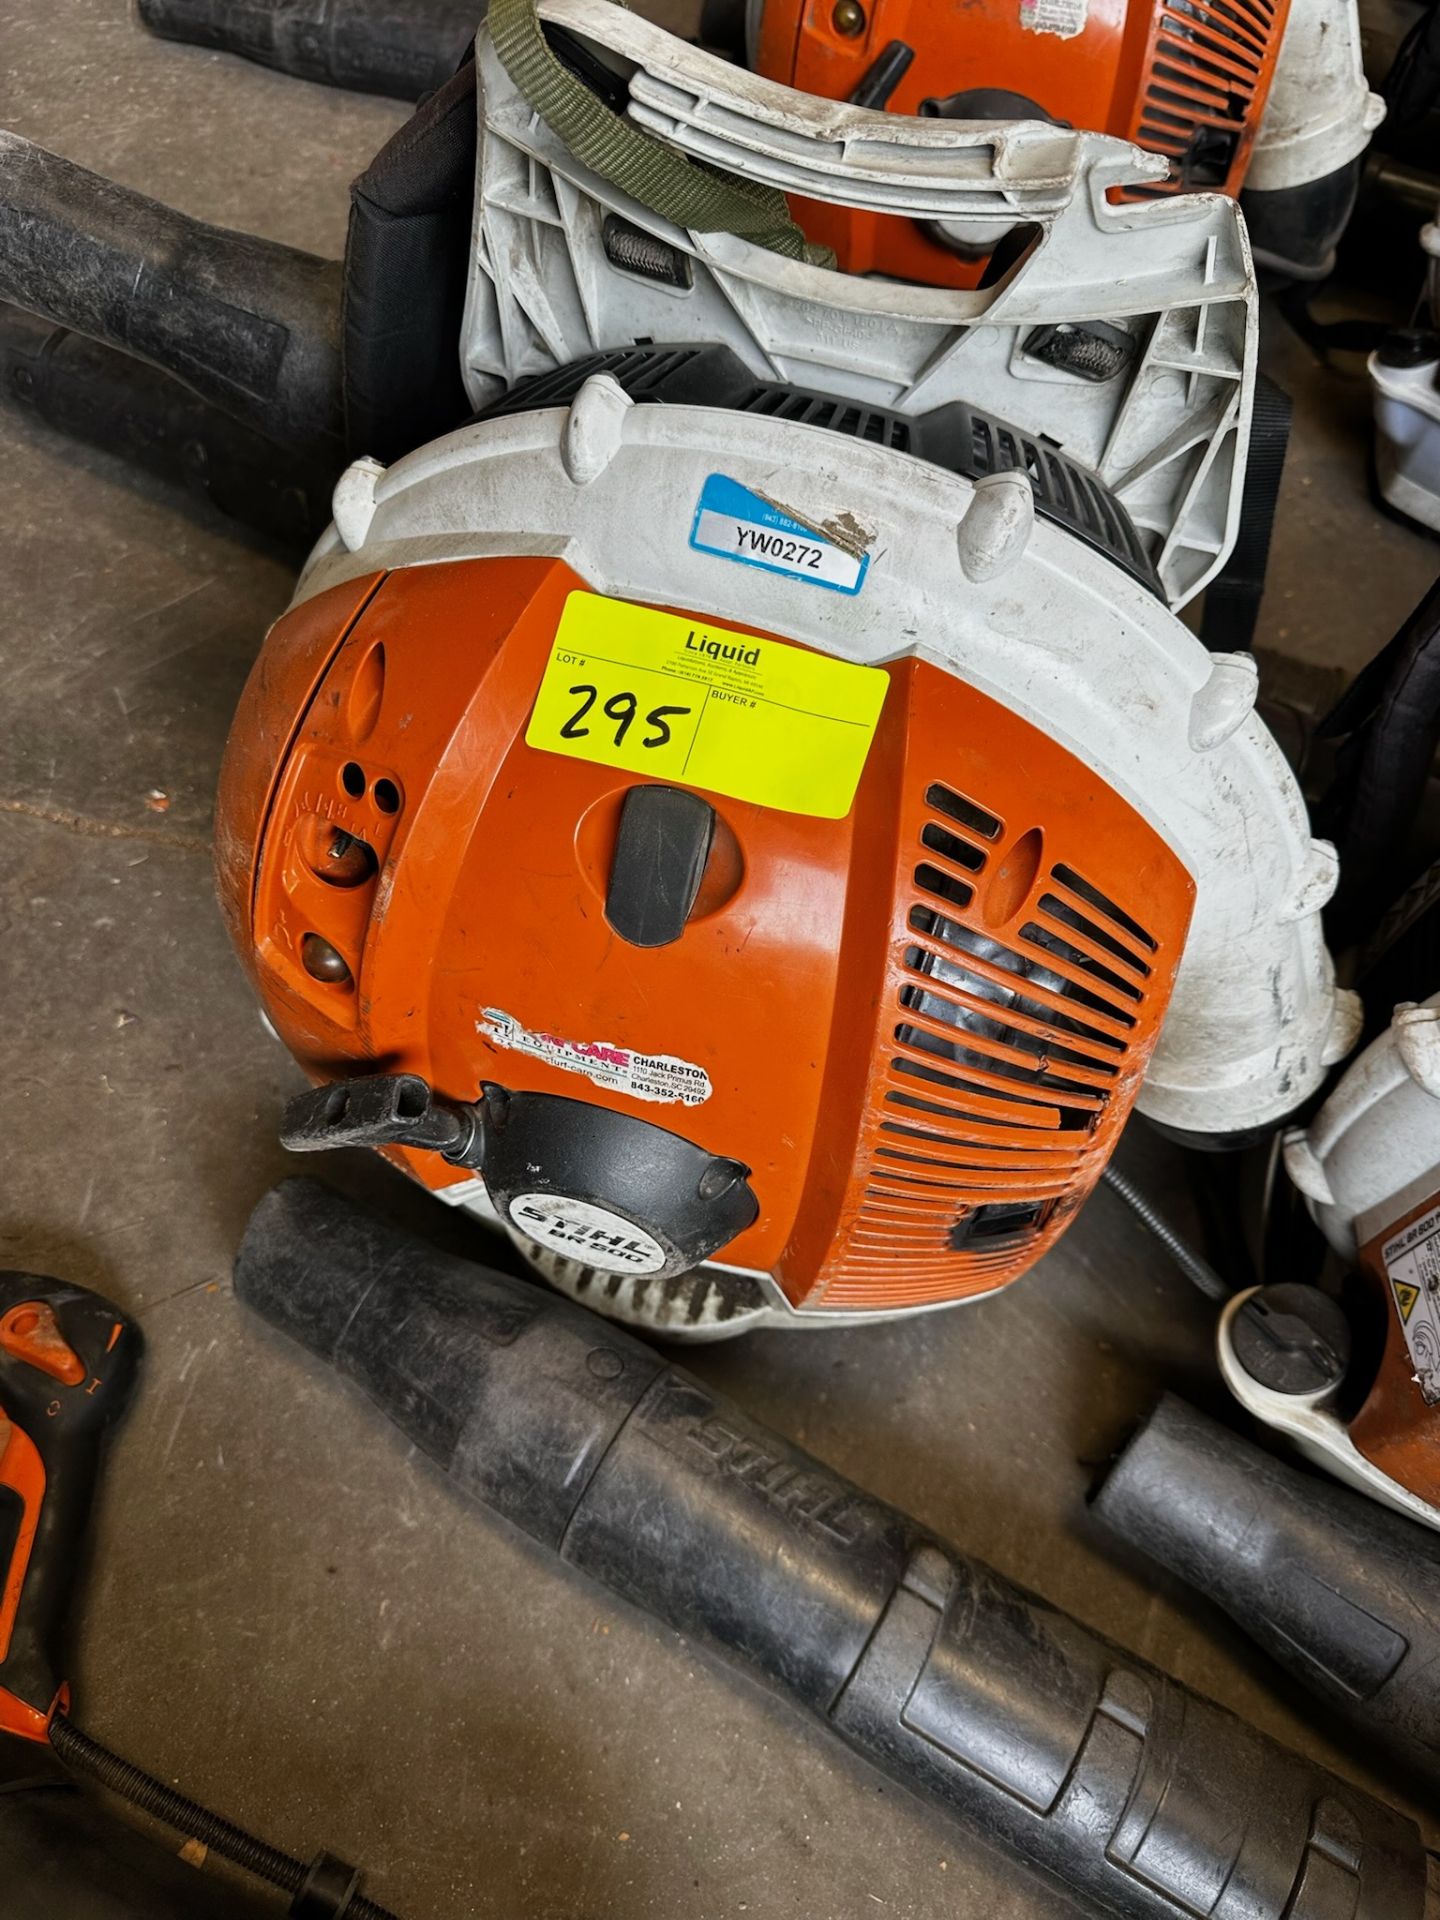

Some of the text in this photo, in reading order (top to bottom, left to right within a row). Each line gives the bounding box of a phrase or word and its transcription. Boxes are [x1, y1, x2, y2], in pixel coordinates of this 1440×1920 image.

[737, 526, 823, 569] YW0272
[556, 652, 577, 665] LOT
[685, 631, 760, 666] Liquid
[711, 690, 757, 708] BUYER #
[560, 684, 691, 748] 295
[633, 1056, 708, 1081] CHARLESTON
[633, 1065, 648, 1074] 1110
[649, 1069, 665, 1079] Jack
[666, 1074, 693, 1085] Primus
[518, 1206, 651, 1258] STIHL
[548, 1229, 586, 1244] BR
